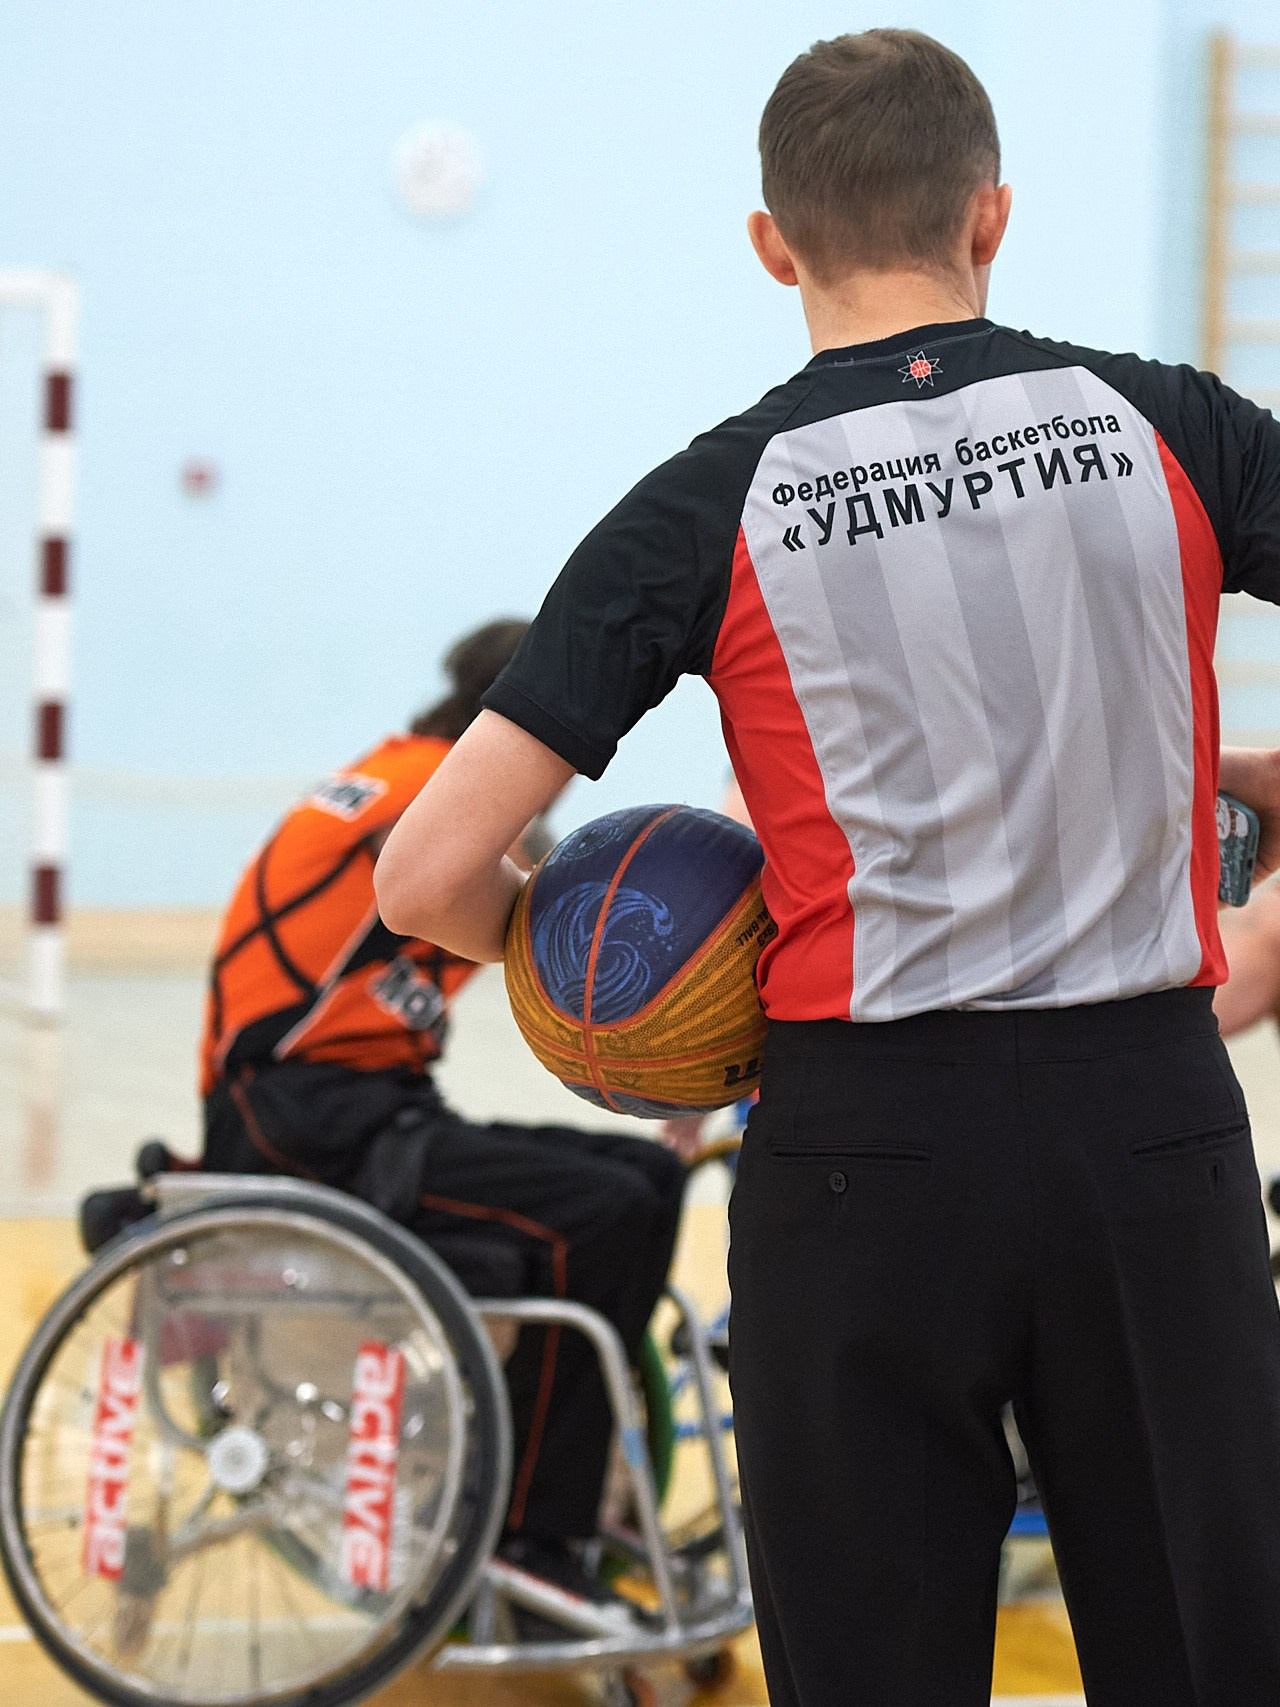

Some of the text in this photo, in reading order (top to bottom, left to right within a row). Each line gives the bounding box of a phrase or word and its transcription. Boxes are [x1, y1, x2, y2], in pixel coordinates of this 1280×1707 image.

[771, 410, 1122, 508] Федерация баскетбола
[781, 442, 1135, 553] «УДМУРТИЯ»
[83, 1338, 142, 1583] active
[342, 1340, 405, 1592] active
